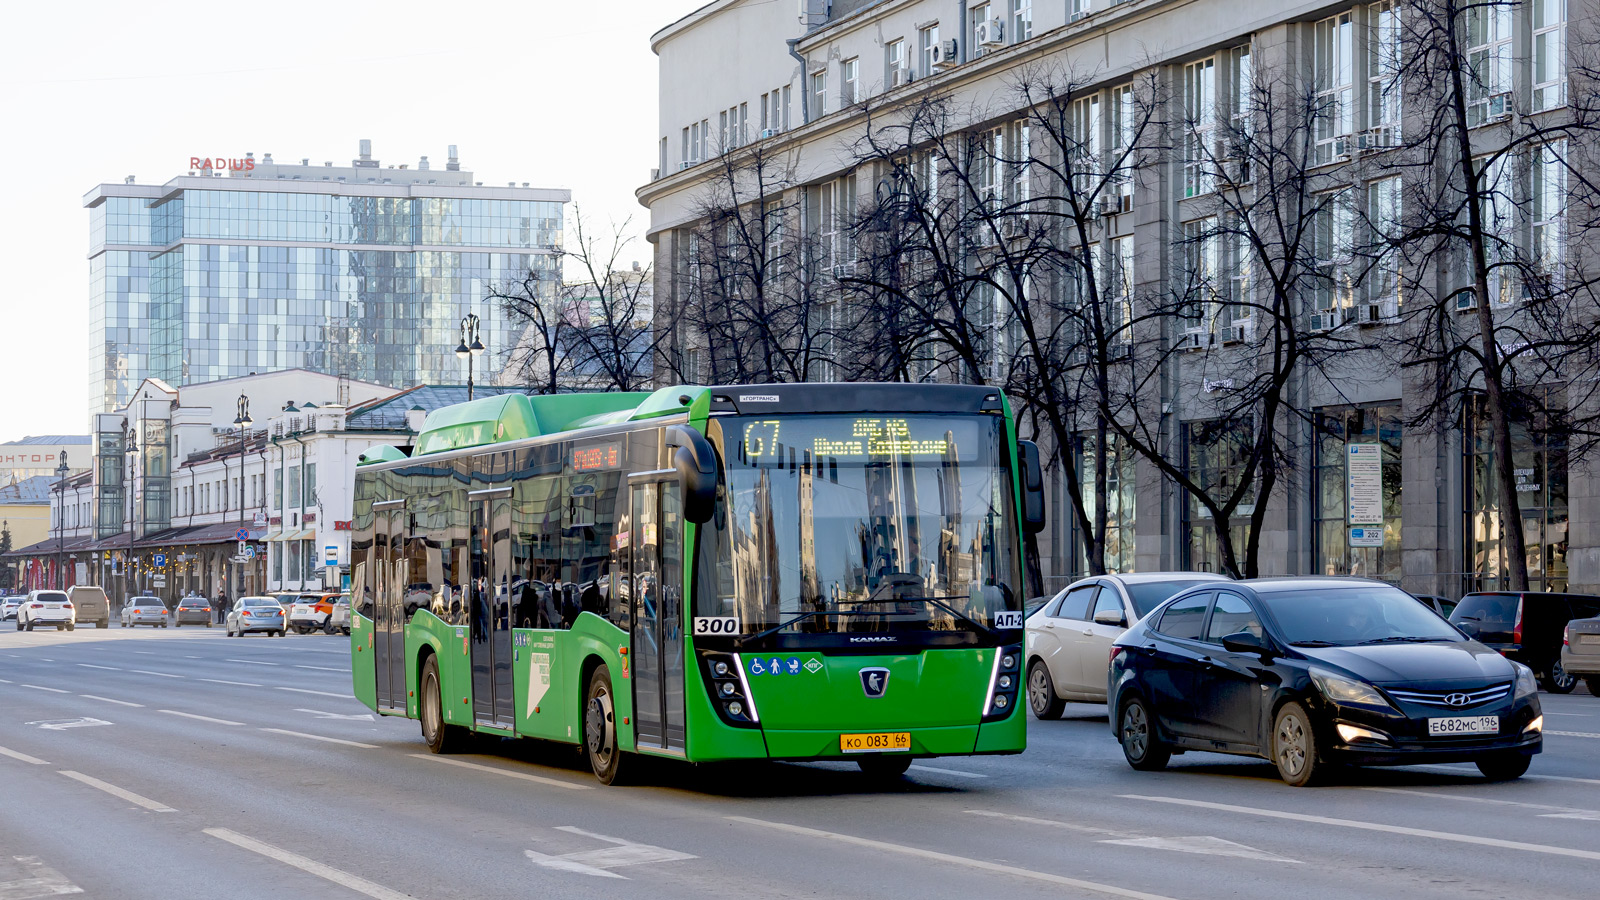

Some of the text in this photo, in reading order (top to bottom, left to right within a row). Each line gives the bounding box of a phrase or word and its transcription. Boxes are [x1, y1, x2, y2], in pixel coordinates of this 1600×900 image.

[190, 157, 255, 171] RADIUS
[745, 420, 780, 456] 67
[814, 437, 947, 455] Школа Созвездие
[697, 619, 736, 633] 300
[1480, 717, 1497, 726] 196
[846, 734, 907, 748] КО 083 66
